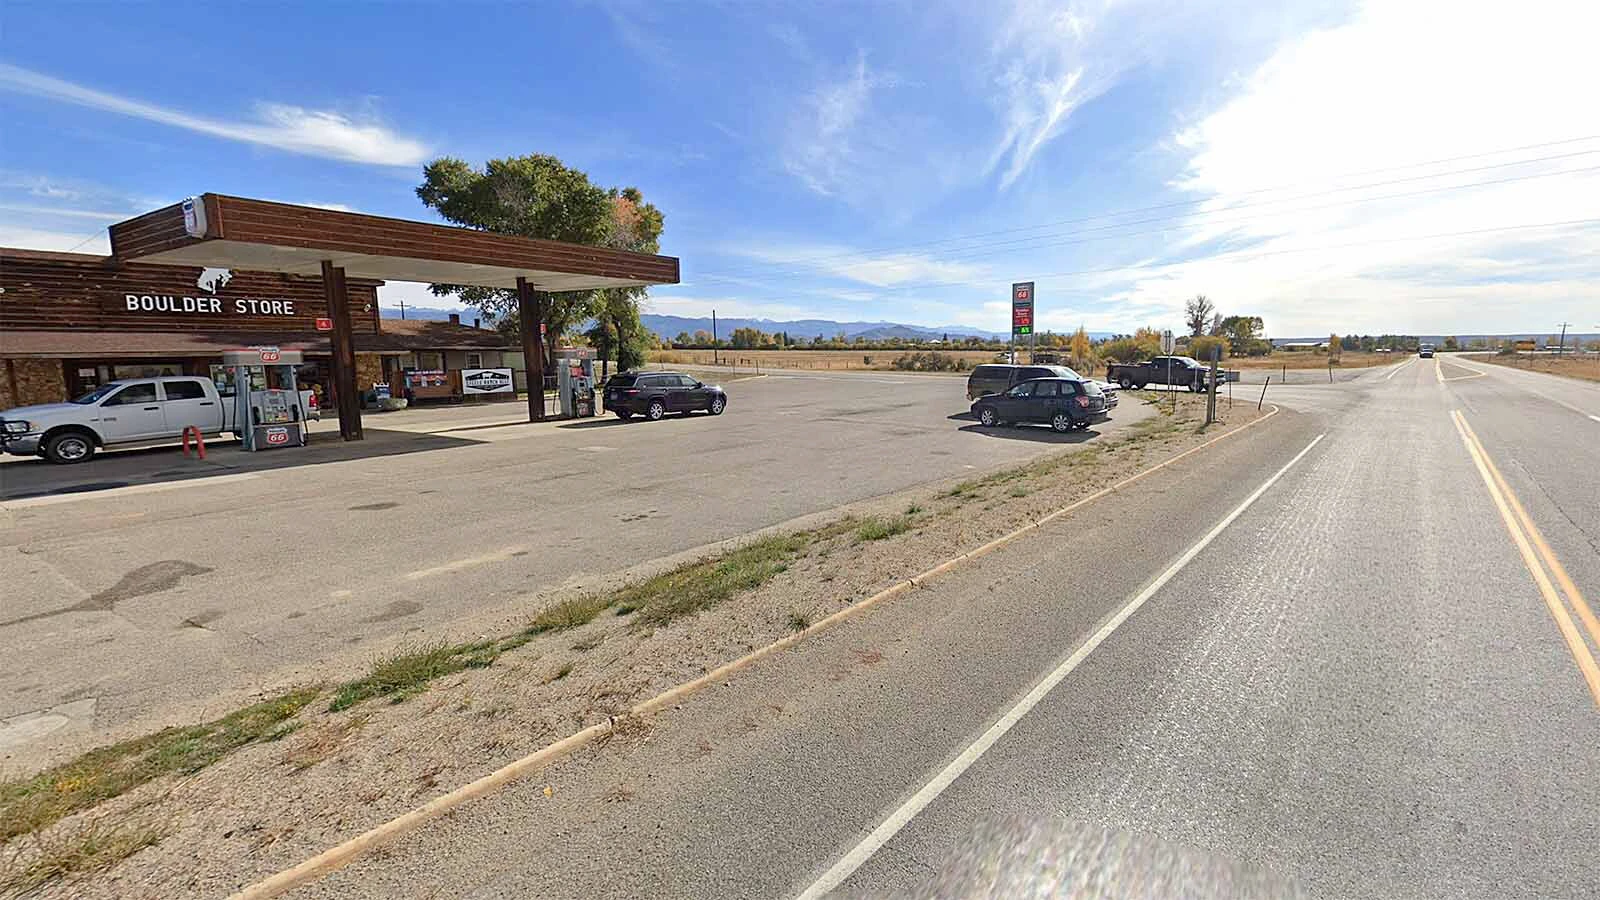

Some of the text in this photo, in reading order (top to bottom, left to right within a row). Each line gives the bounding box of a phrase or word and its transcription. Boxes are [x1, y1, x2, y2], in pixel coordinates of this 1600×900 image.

[125, 295, 295, 315] BOULDER STORE
[262, 352, 278, 361] 66
[270, 433, 285, 442] 66
